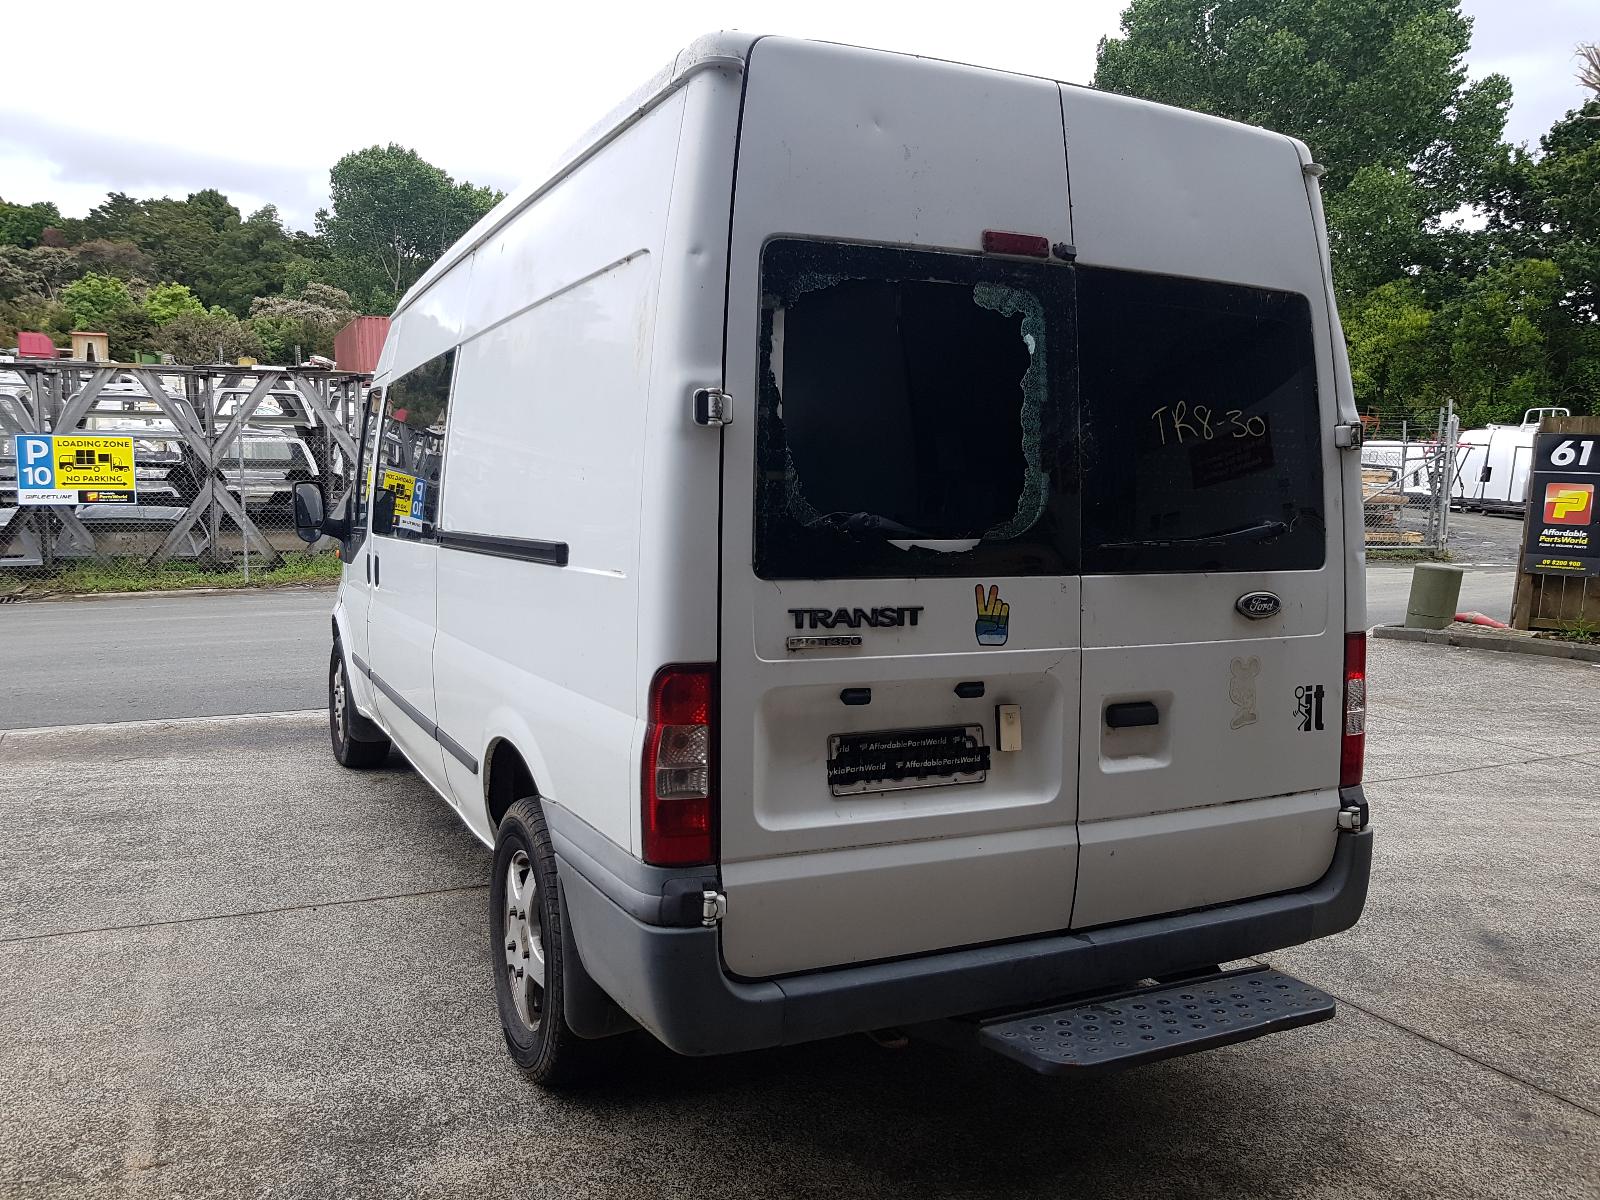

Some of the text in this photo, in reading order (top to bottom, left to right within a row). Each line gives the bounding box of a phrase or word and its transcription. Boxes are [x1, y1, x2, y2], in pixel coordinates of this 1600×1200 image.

[1151, 400, 1266, 445] TR8-30
[27, 440, 49, 465] P
[1550, 440, 1594, 466] 61
[23, 467, 51, 486] 10
[1539, 536, 1588, 544] PartsWorld
[1541, 529, 1588, 537] Affordable
[1250, 597, 1274, 612] Ford
[788, 606, 924, 629] TRANSIT
[905, 755, 981, 768] AffordablePartsWorld
